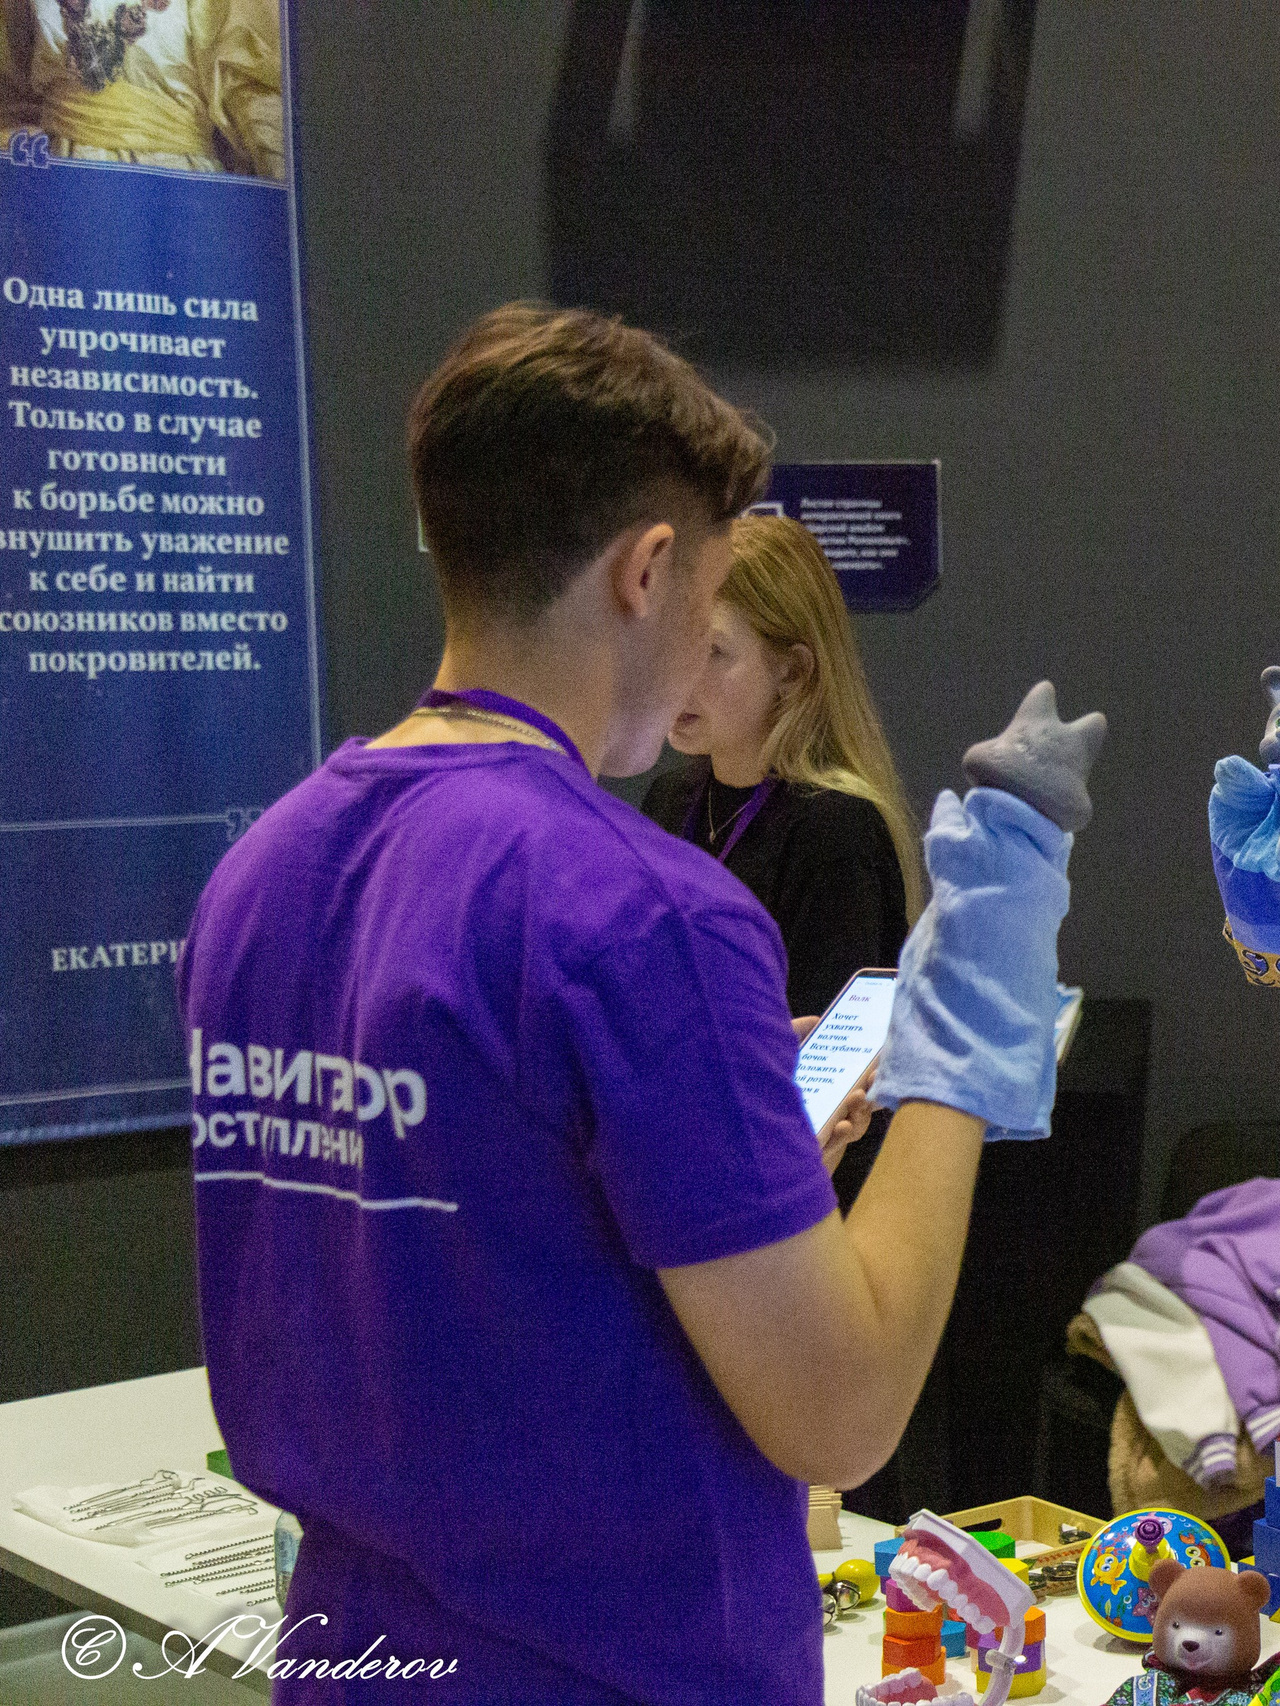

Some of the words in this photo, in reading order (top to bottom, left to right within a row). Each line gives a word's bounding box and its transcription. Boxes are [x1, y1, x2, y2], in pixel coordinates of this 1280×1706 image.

[3, 277, 85, 310] Одна
[93, 289, 178, 316] лишь
[184, 297, 259, 321] сила
[40, 326, 226, 358] упрочивает
[9, 365, 259, 400] независимость.
[8, 401, 125, 432] Только
[134, 413, 152, 433] в
[158, 414, 263, 443] случае
[48, 448, 227, 477] готовности
[12, 488, 33, 511] к
[40, 481, 155, 519] борьбе
[161, 493, 265, 516] можно
[141, 532, 290, 561] уважение
[29, 569, 48, 592] к
[55, 563, 127, 592] себе
[135, 571, 155, 594] и
[163, 565, 255, 594] найти
[0, 610, 174, 632] союзников
[180, 611, 288, 632] вместо
[28, 643, 262, 680] покровителей.
[52, 939, 188, 972] ЕКАТЕРИ
[848, 994, 871, 1003] Волк
[823, 1024, 863, 1032] ухватить
[832, 1012, 859, 1021] Хочет
[809, 1042, 830, 1051] Всех
[817, 1034, 849, 1042] волчок
[801, 1053, 828, 1062] бочок
